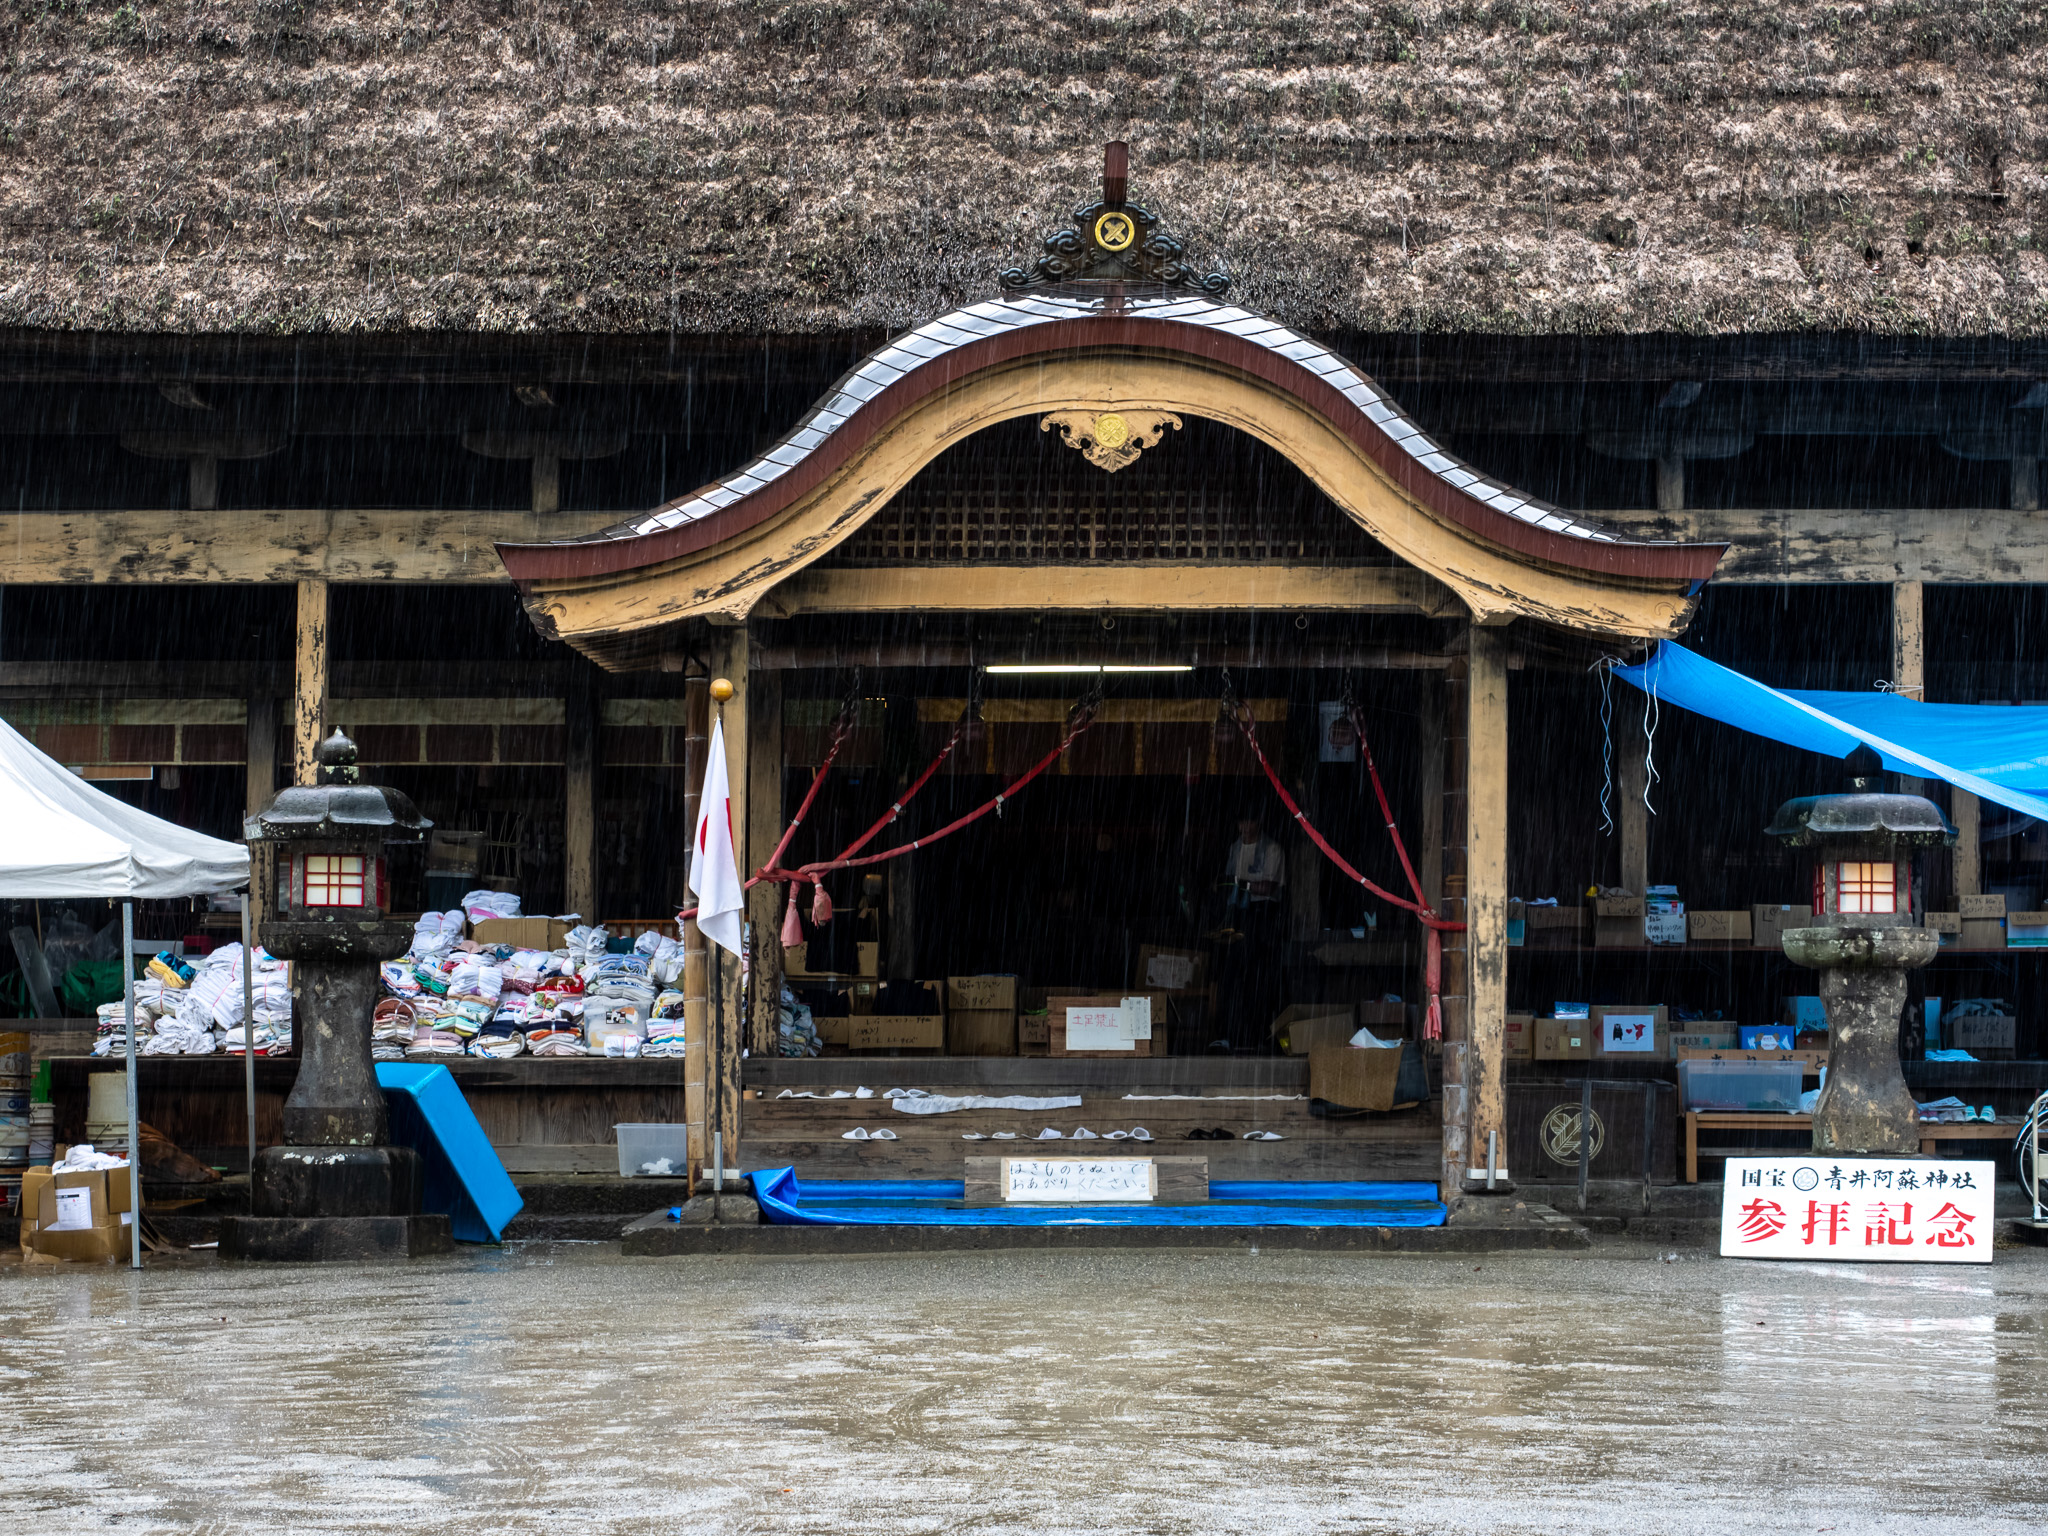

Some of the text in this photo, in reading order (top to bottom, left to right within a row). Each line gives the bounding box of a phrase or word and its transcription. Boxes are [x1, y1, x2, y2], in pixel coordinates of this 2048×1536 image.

[1072, 1013, 1119, 1028] 土足禁止
[1010, 1162, 1145, 1177] はきものをぬいで
[1741, 1164, 1978, 1191] 国宝 青井阿蘇神社
[1736, 1196, 1977, 1248] 参拝記念
